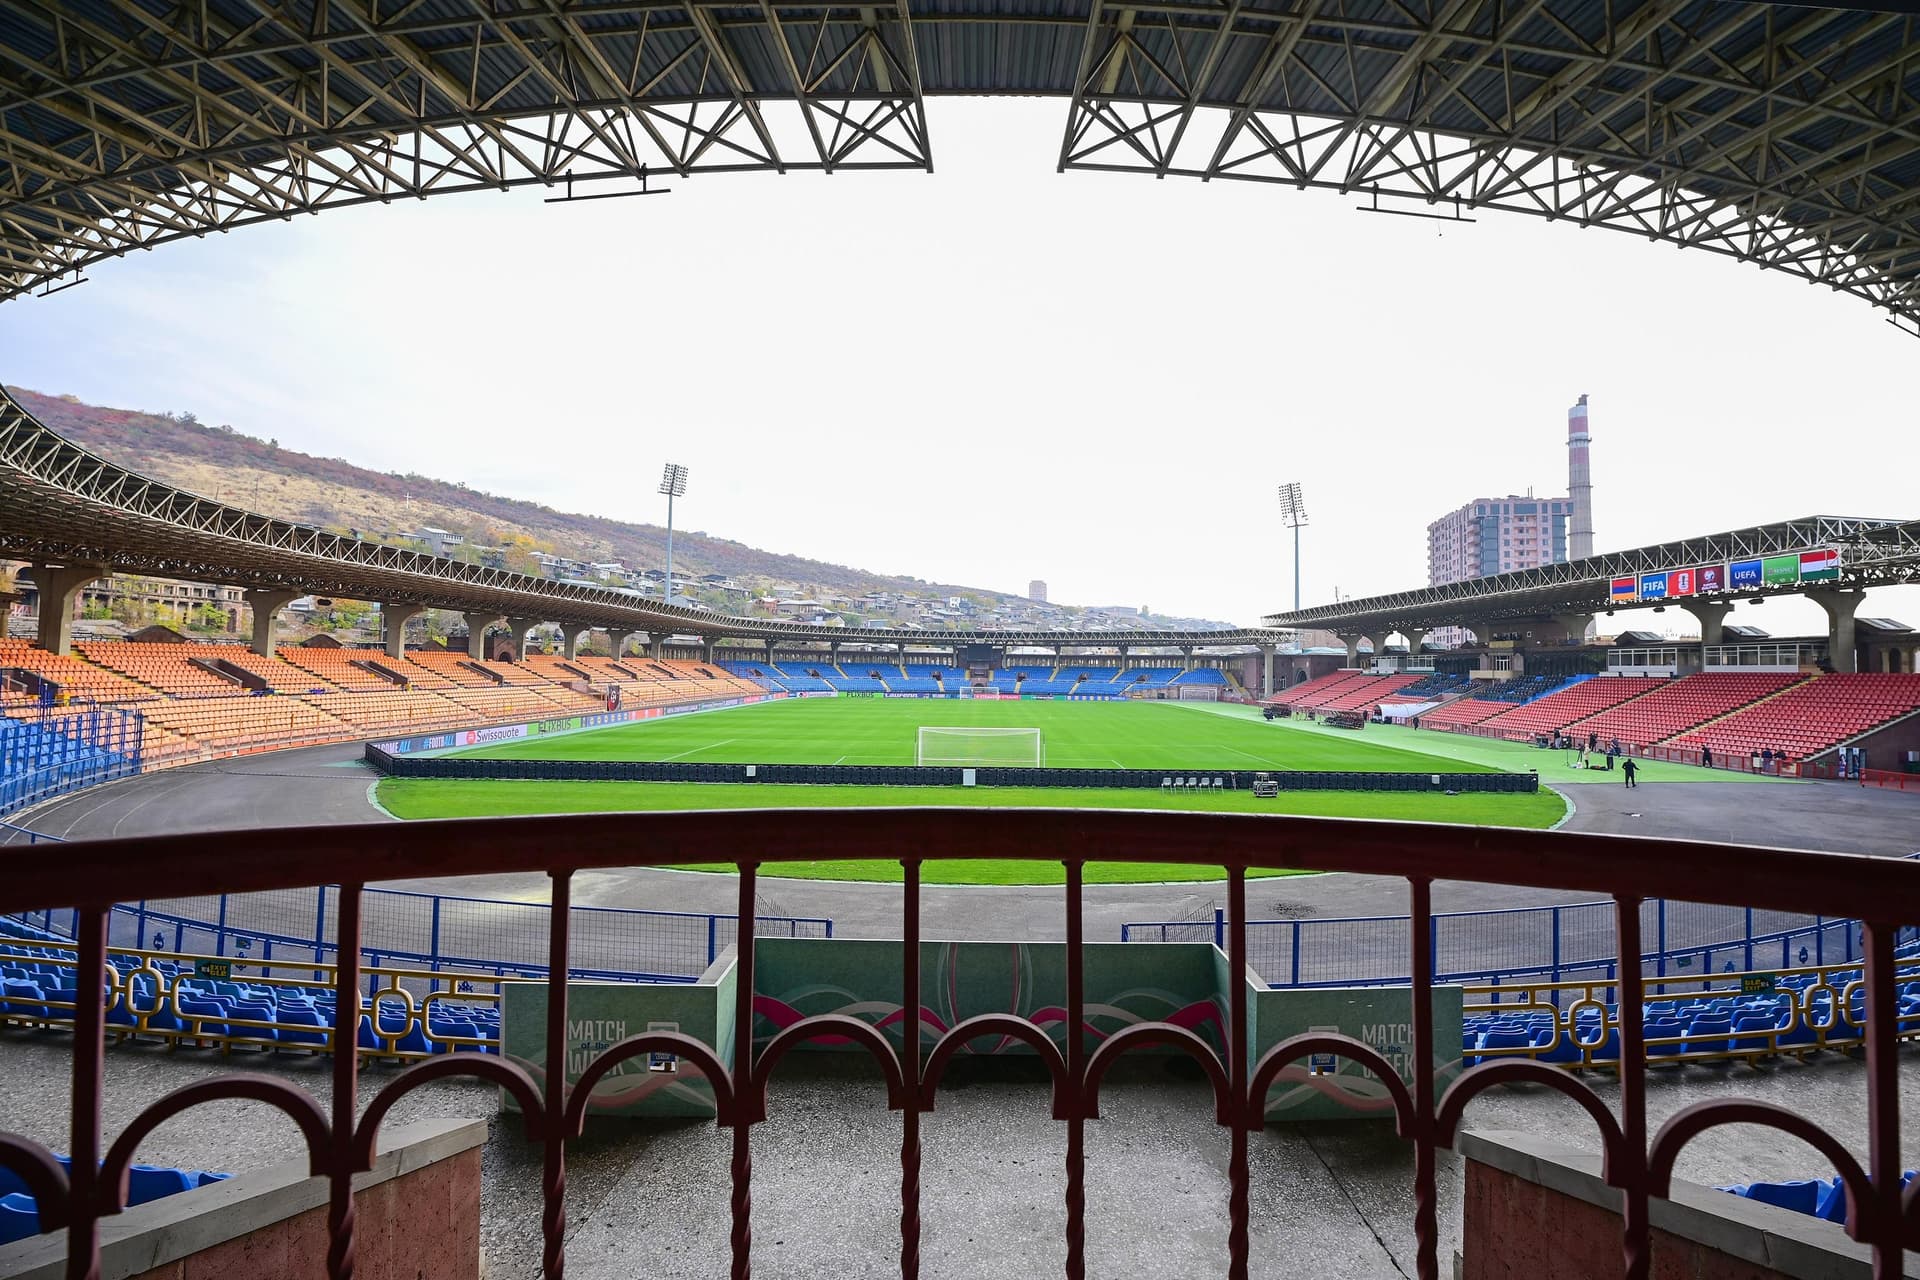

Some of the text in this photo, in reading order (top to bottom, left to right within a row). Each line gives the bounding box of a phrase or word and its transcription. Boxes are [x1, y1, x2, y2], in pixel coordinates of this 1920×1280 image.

[1734, 570, 1757, 579] UEFA
[1643, 581, 1665, 592] FIFA
[477, 727, 519, 742] Swissquote
[568, 1020, 626, 1040] MATCH
[1361, 1024, 1415, 1044] MATCH
[581, 1041, 610, 1049] of the
[1387, 1044, 1402, 1053] the
